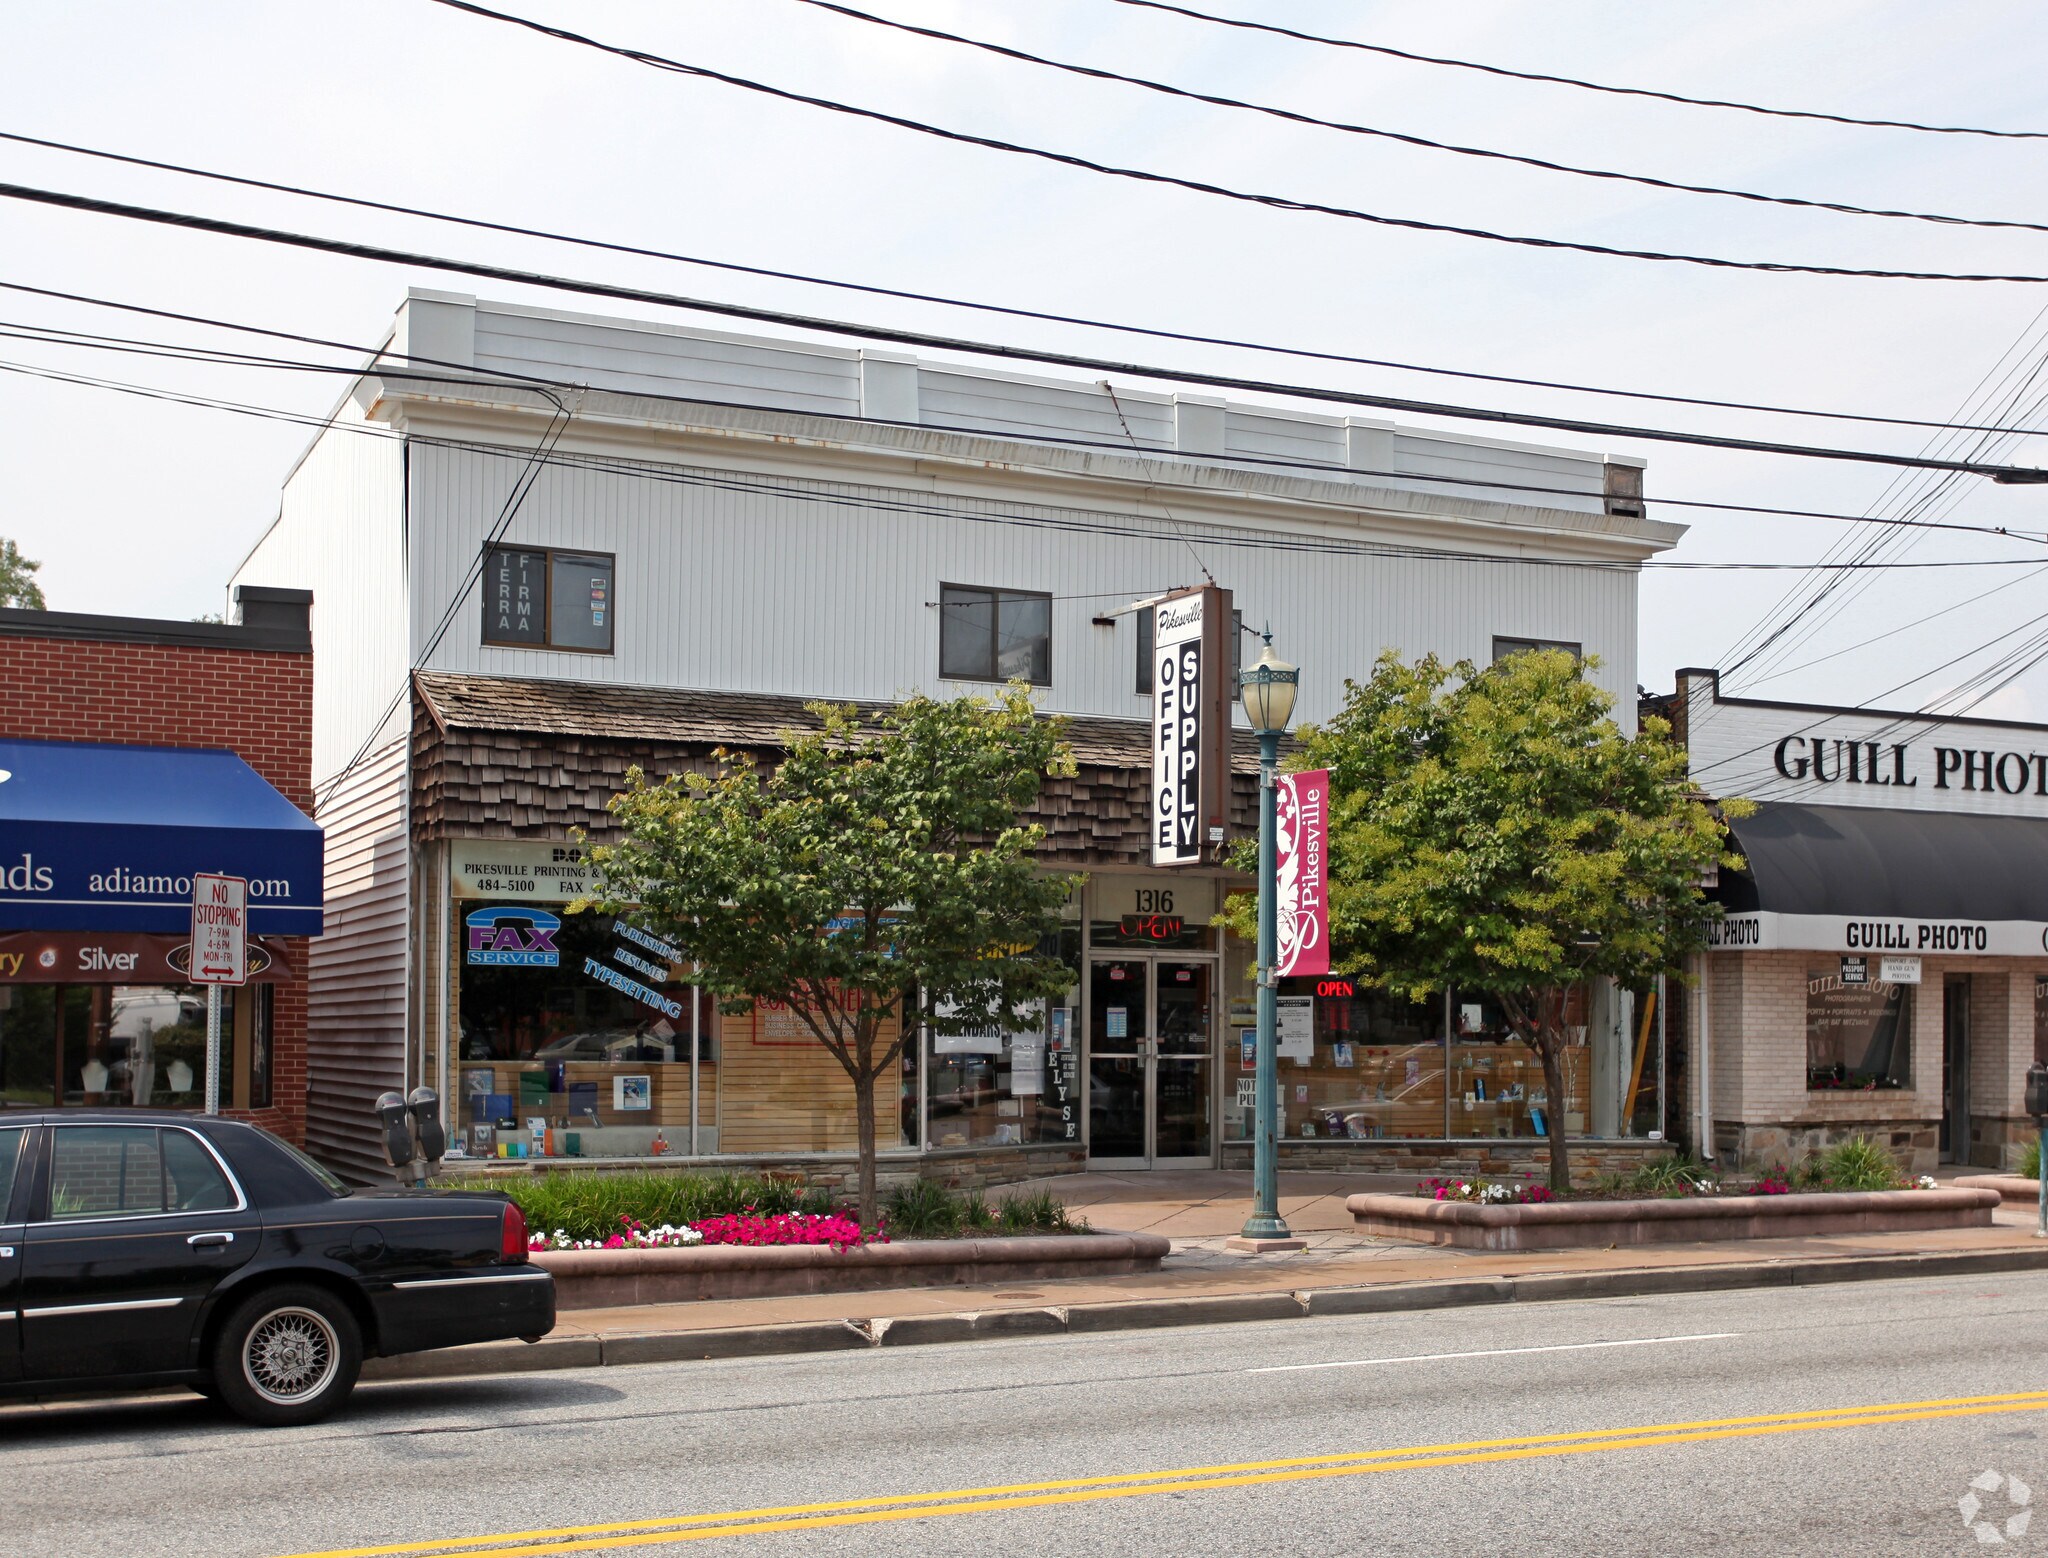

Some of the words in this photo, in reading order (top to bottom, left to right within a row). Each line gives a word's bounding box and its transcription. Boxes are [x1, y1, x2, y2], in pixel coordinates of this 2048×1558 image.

[498, 553, 511, 629] TERRA
[517, 555, 531, 631] FIRMA
[1158, 601, 1203, 640] Pikesville
[1158, 657, 1175, 849] OFFICE
[1181, 651, 1198, 847] SUPPLY
[1773, 736, 1918, 787] GUILL
[1933, 747, 2048, 796] PHOT
[1302, 788, 1321, 908] Pikesville
[464, 863, 529, 876] PIKESVILLE
[534, 865, 587, 878] PRINTING
[591, 867, 600, 878] &
[212, 884, 229, 904] NO
[477, 878, 535, 892] 484-5100
[559, 881, 584, 893] FAX
[1135, 889, 1174, 913] 1316
[197, 904, 241, 927] STOPPING
[1120, 915, 1180, 938] OPEN
[468, 926, 560, 951] FAX
[612, 920, 683, 964] PUBLISHING
[1724, 919, 1759, 945] PHOTO
[1846, 922, 1910, 949] GUILL
[1918, 924, 1987, 951] PHOTO
[78, 946, 139, 970] Silver
[469, 953, 557, 964] SERVICE
[614, 947, 669, 982] RESUMES
[1842, 965, 1866, 973] PASSPORT
[583, 957, 683, 1018] TYPESETTING
[1317, 981, 1353, 997] OPEN
[1807, 975, 1845, 995] UILL
[1845, 973, 1864, 981] SERVICE
[1048, 1052, 1076, 1138] ELYSE
[1237, 1079, 1257, 1092] NOT
